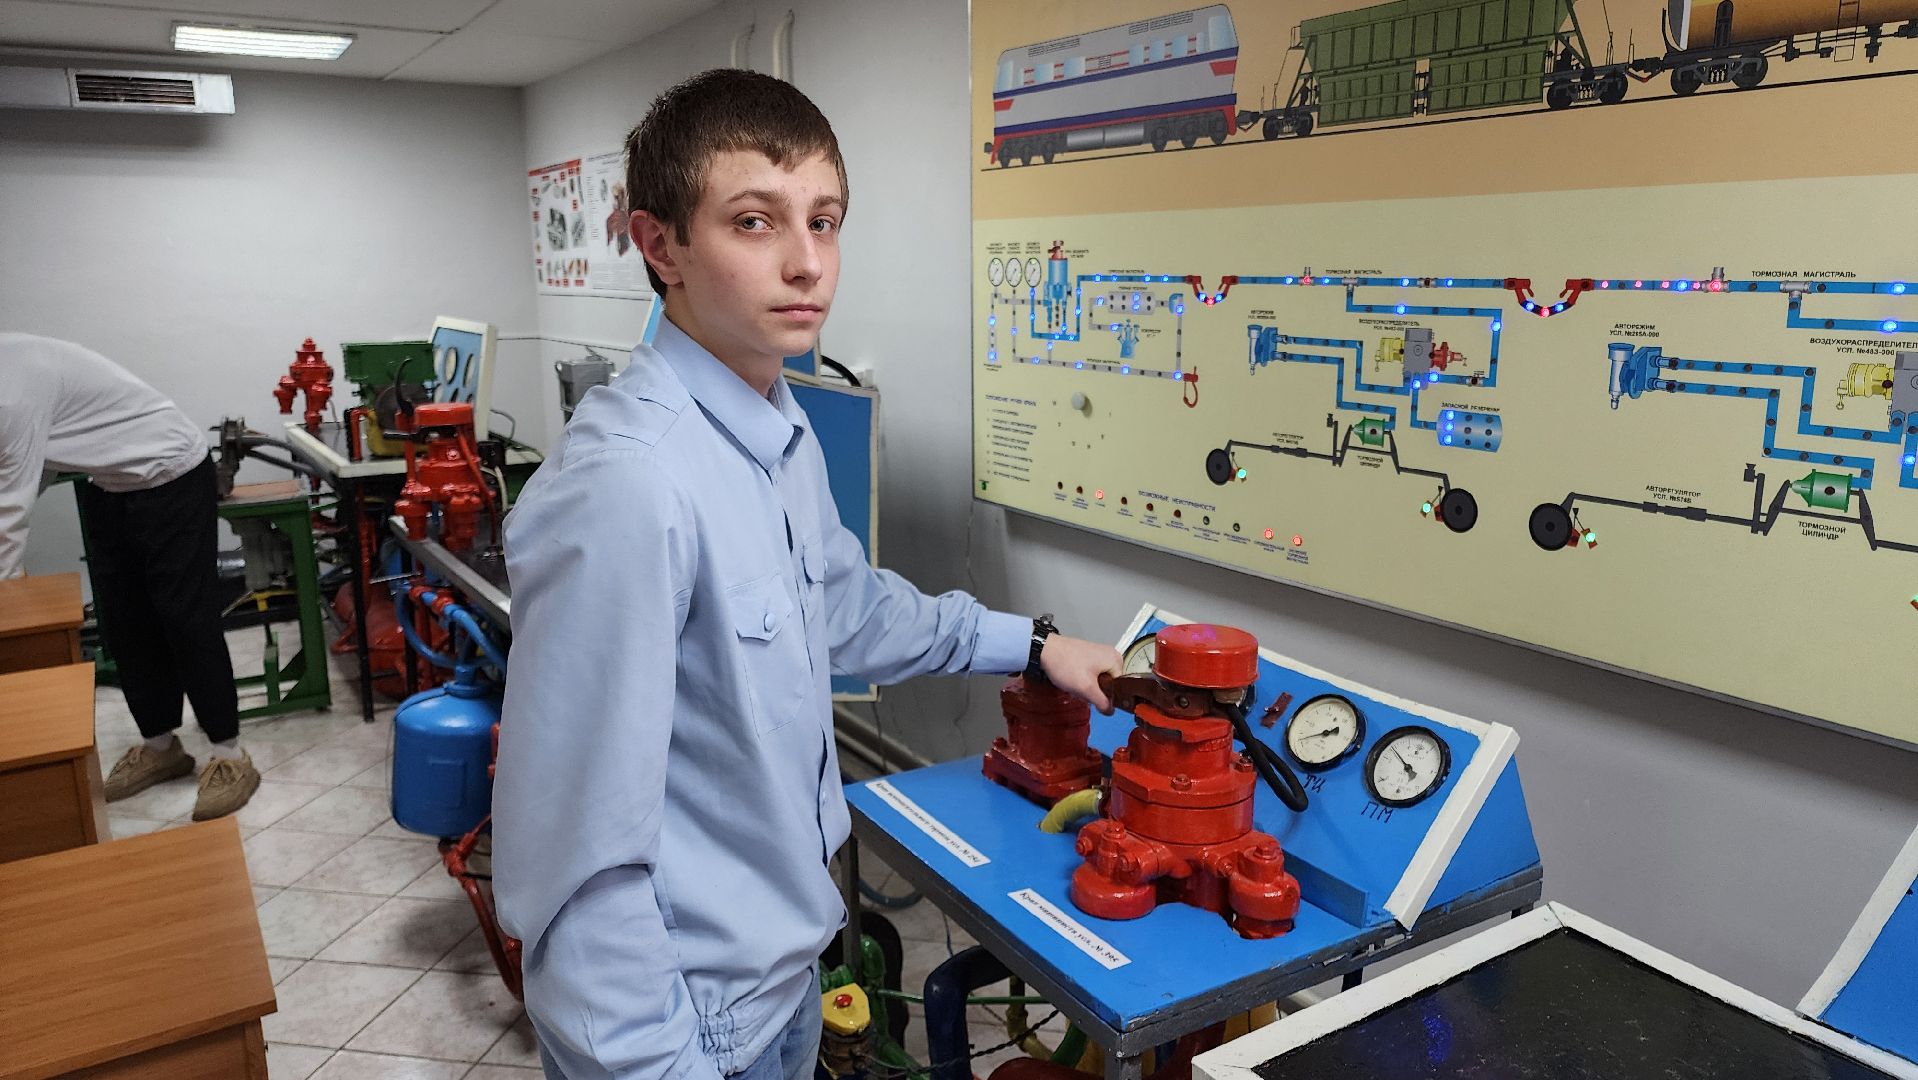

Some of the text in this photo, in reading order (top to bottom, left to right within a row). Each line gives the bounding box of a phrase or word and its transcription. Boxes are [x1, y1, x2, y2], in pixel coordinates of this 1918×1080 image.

[1751, 270, 1798, 278] ТОРМОЗНАЯ
[1798, 520, 1846, 534] ТОРМОЗНОЙ
[1801, 528, 1839, 540] ЦИЛИНДР
[1361, 801, 1393, 823] ПМ
